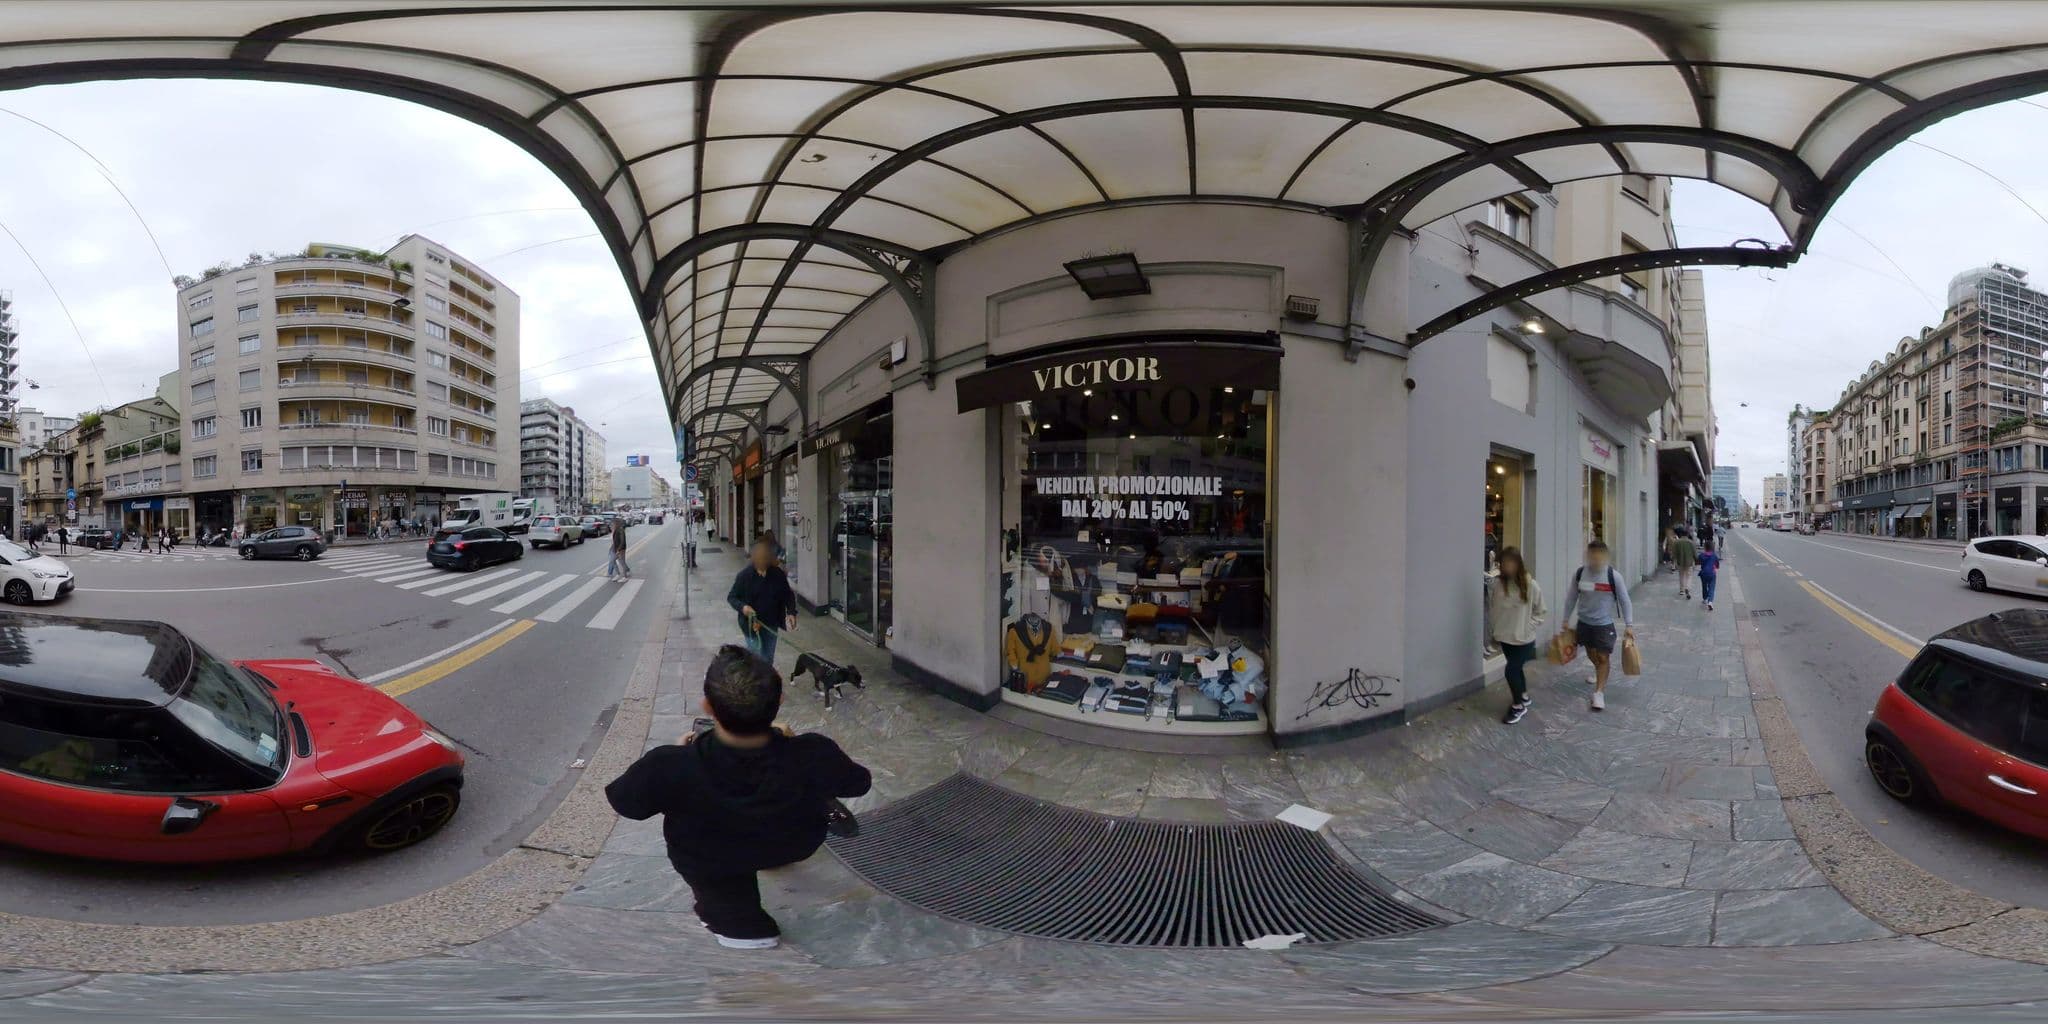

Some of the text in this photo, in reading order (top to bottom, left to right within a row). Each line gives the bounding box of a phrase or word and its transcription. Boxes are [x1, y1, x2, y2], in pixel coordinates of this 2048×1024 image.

[1032, 357, 1162, 392] VICTOR
[1036, 475, 1223, 497] VENDITA PROMOZIONALE
[1061, 500, 1190, 521] DAL 20% AL 50%
